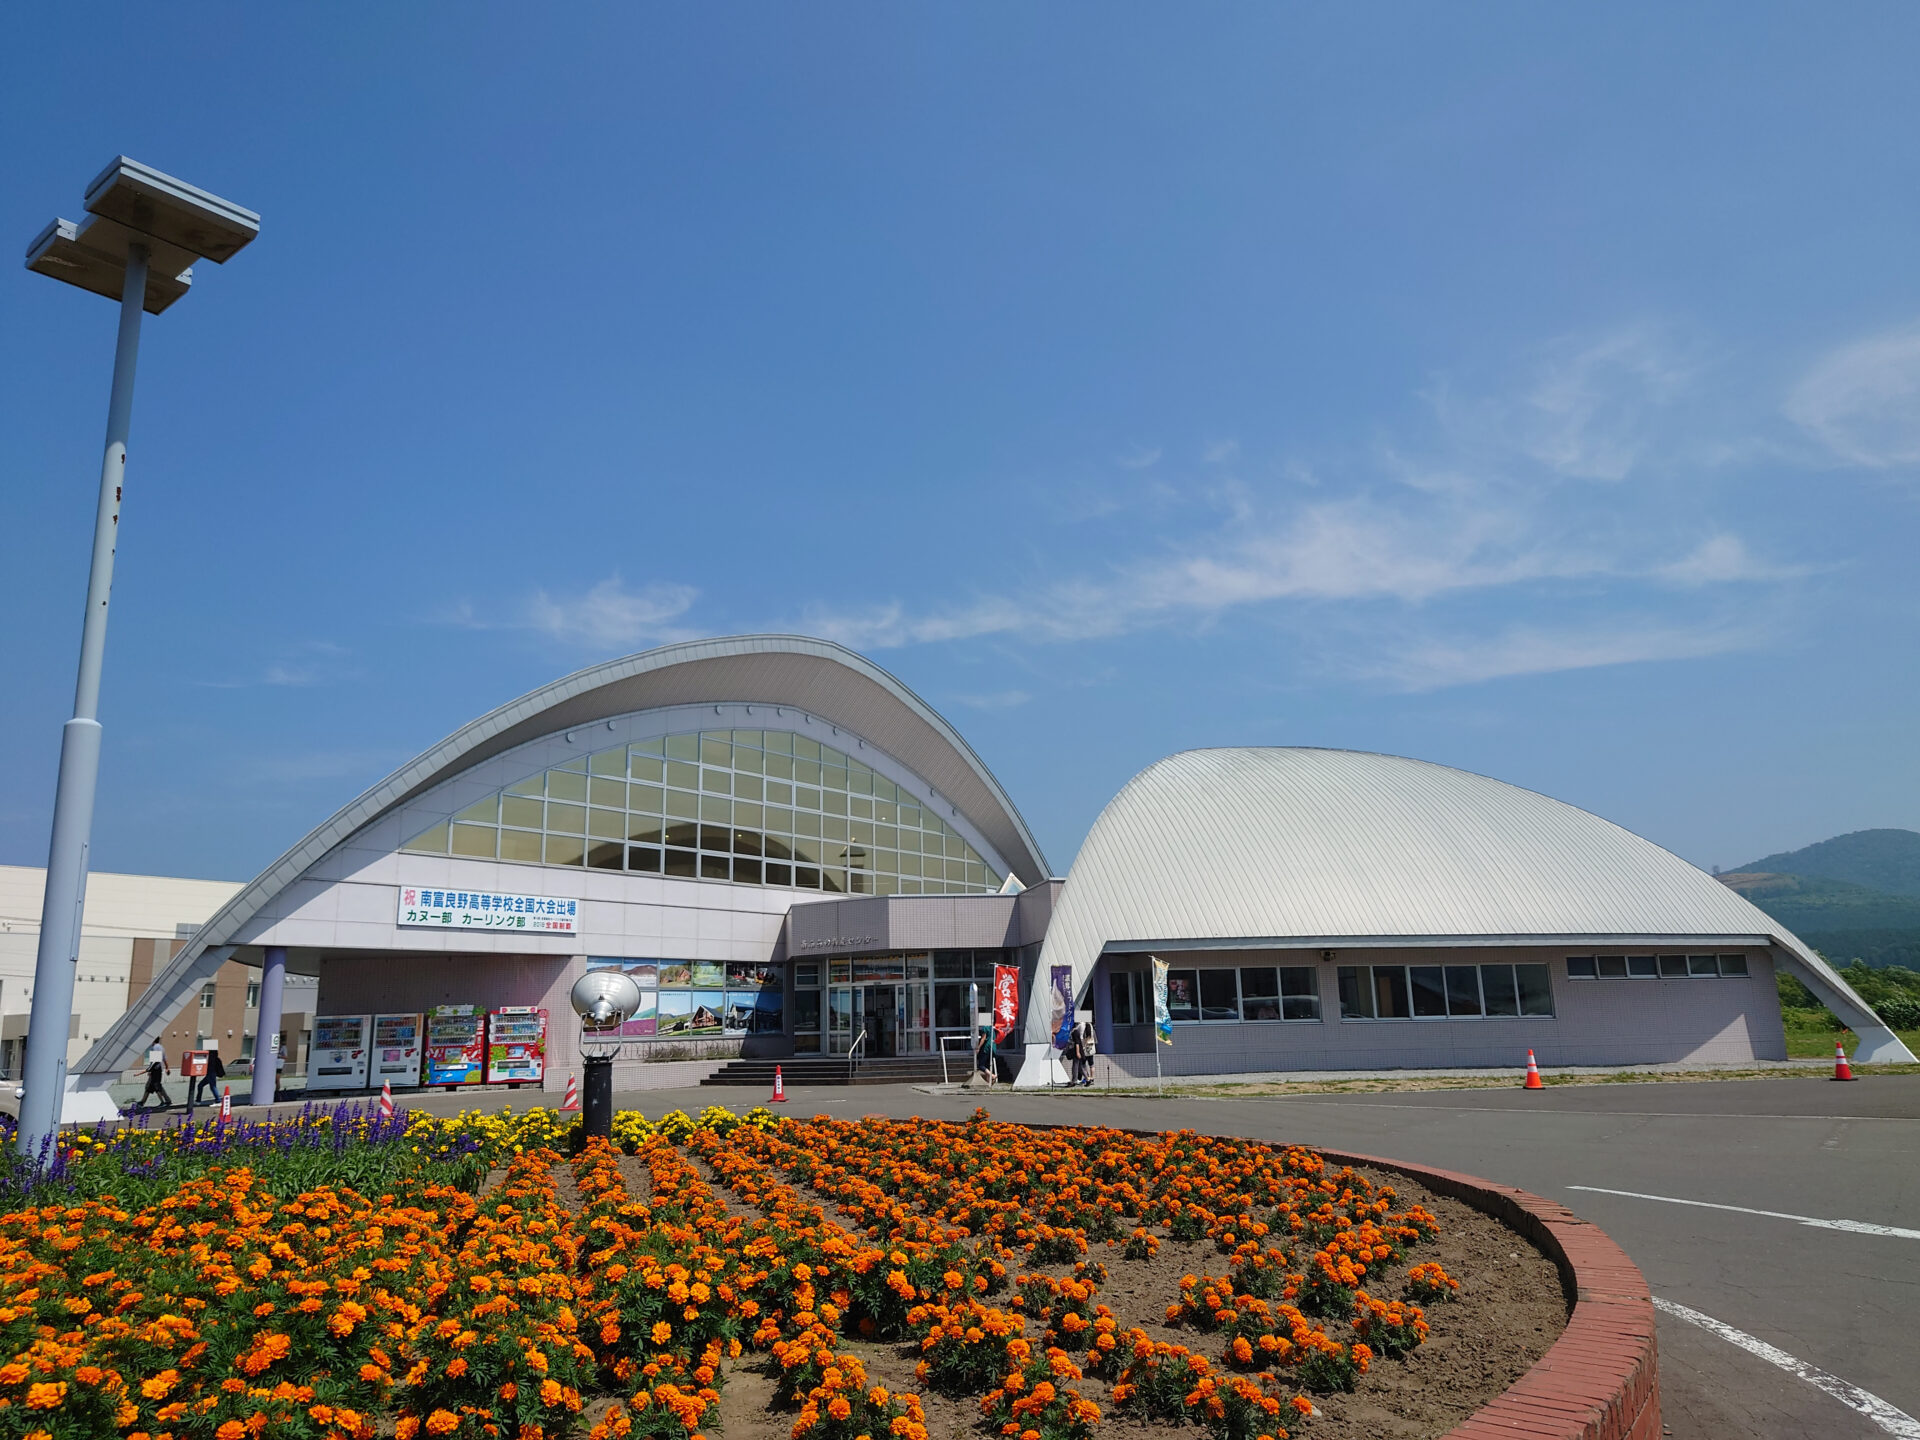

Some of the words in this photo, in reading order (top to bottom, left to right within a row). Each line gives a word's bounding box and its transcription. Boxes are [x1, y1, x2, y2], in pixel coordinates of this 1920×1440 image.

[404, 889, 416, 906] 祝
[421, 890, 577, 916] 南富良野高等学校全国大会出場
[407, 909, 452, 924] カヌー部
[462, 912, 526, 928] カーリング部
